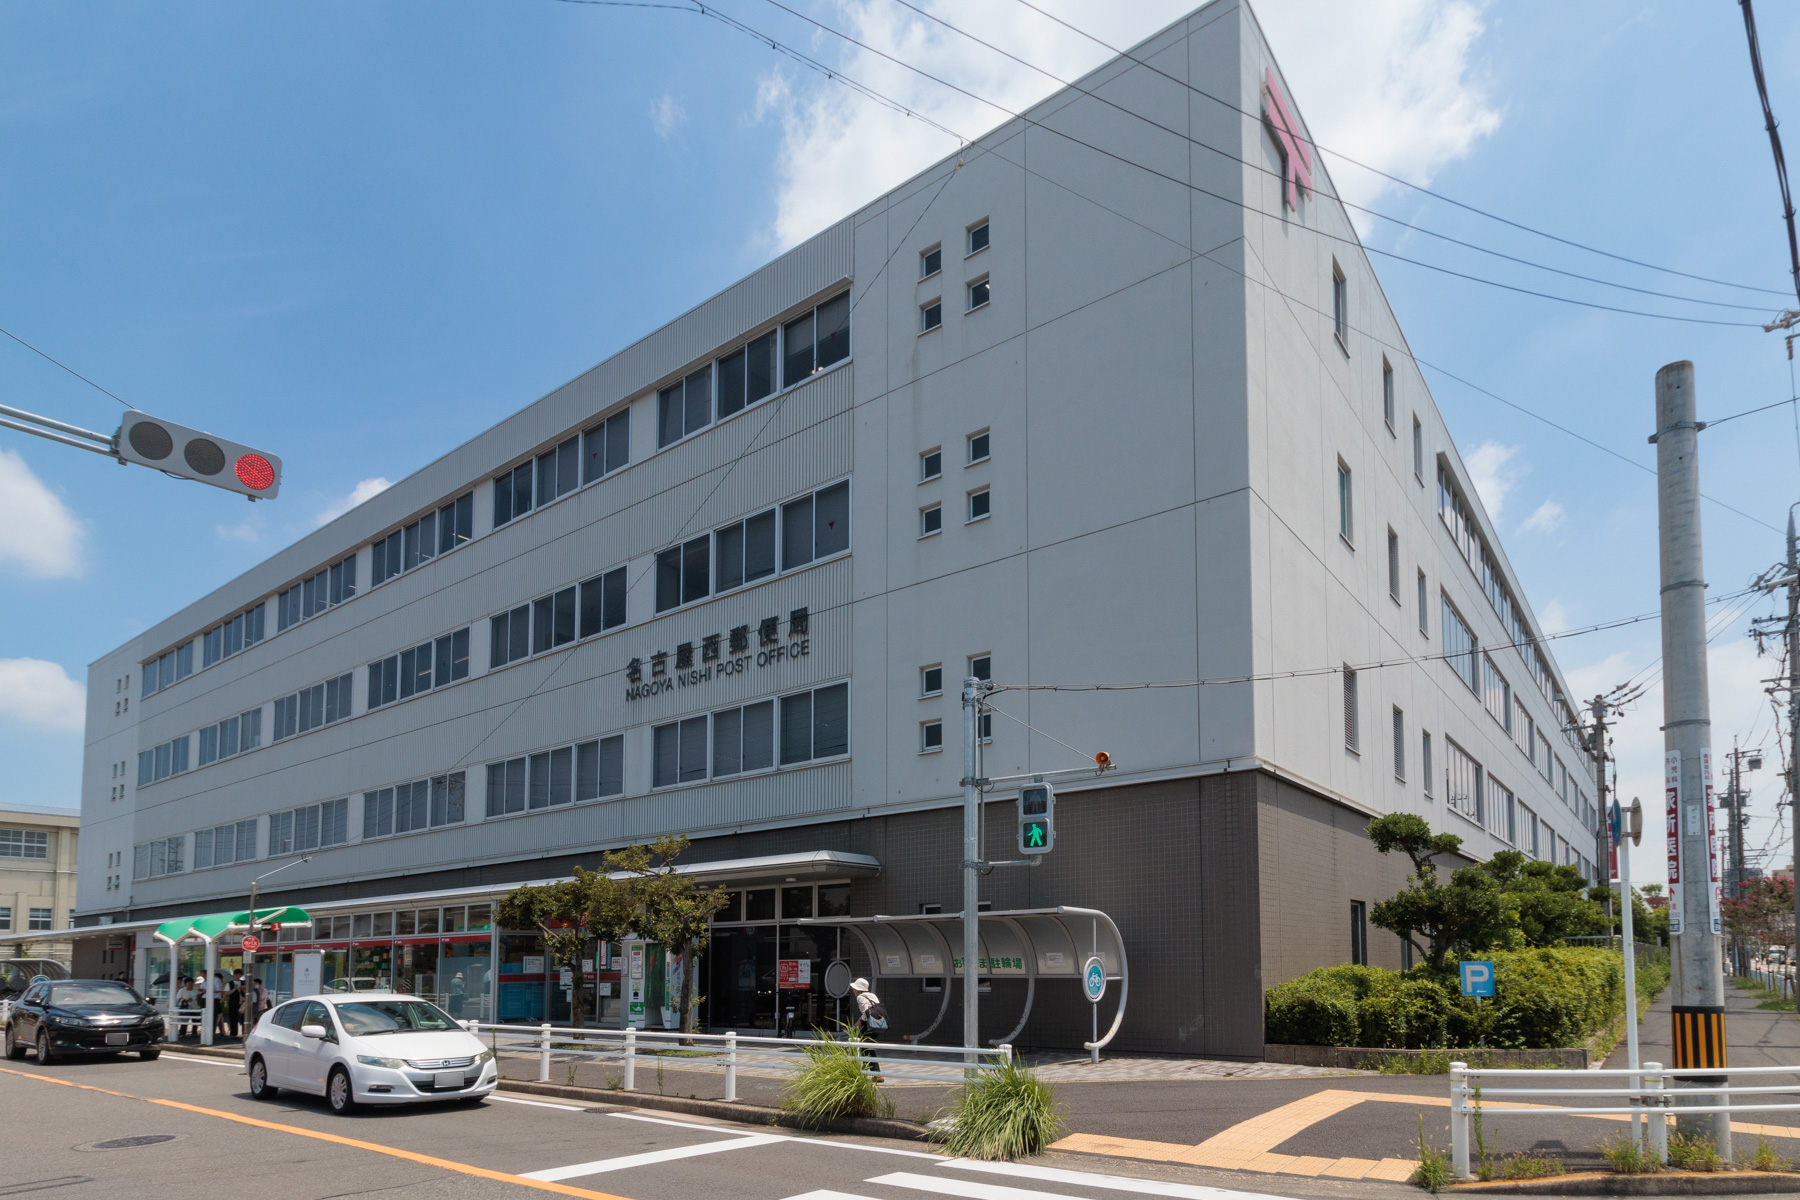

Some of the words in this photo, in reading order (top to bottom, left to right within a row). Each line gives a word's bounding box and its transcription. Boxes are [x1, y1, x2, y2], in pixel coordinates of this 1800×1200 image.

[626, 606, 809, 683] 名古屋西郵便局
[625, 677, 674, 702] NAGOYA
[678, 666, 712, 689] NISHI
[716, 655, 752, 678] POST
[756, 639, 810, 667] OFFICE
[273, 922, 280, 930] 1
[953, 957, 1023, 970] おま駐輪場
[1466, 965, 1489, 993] P
